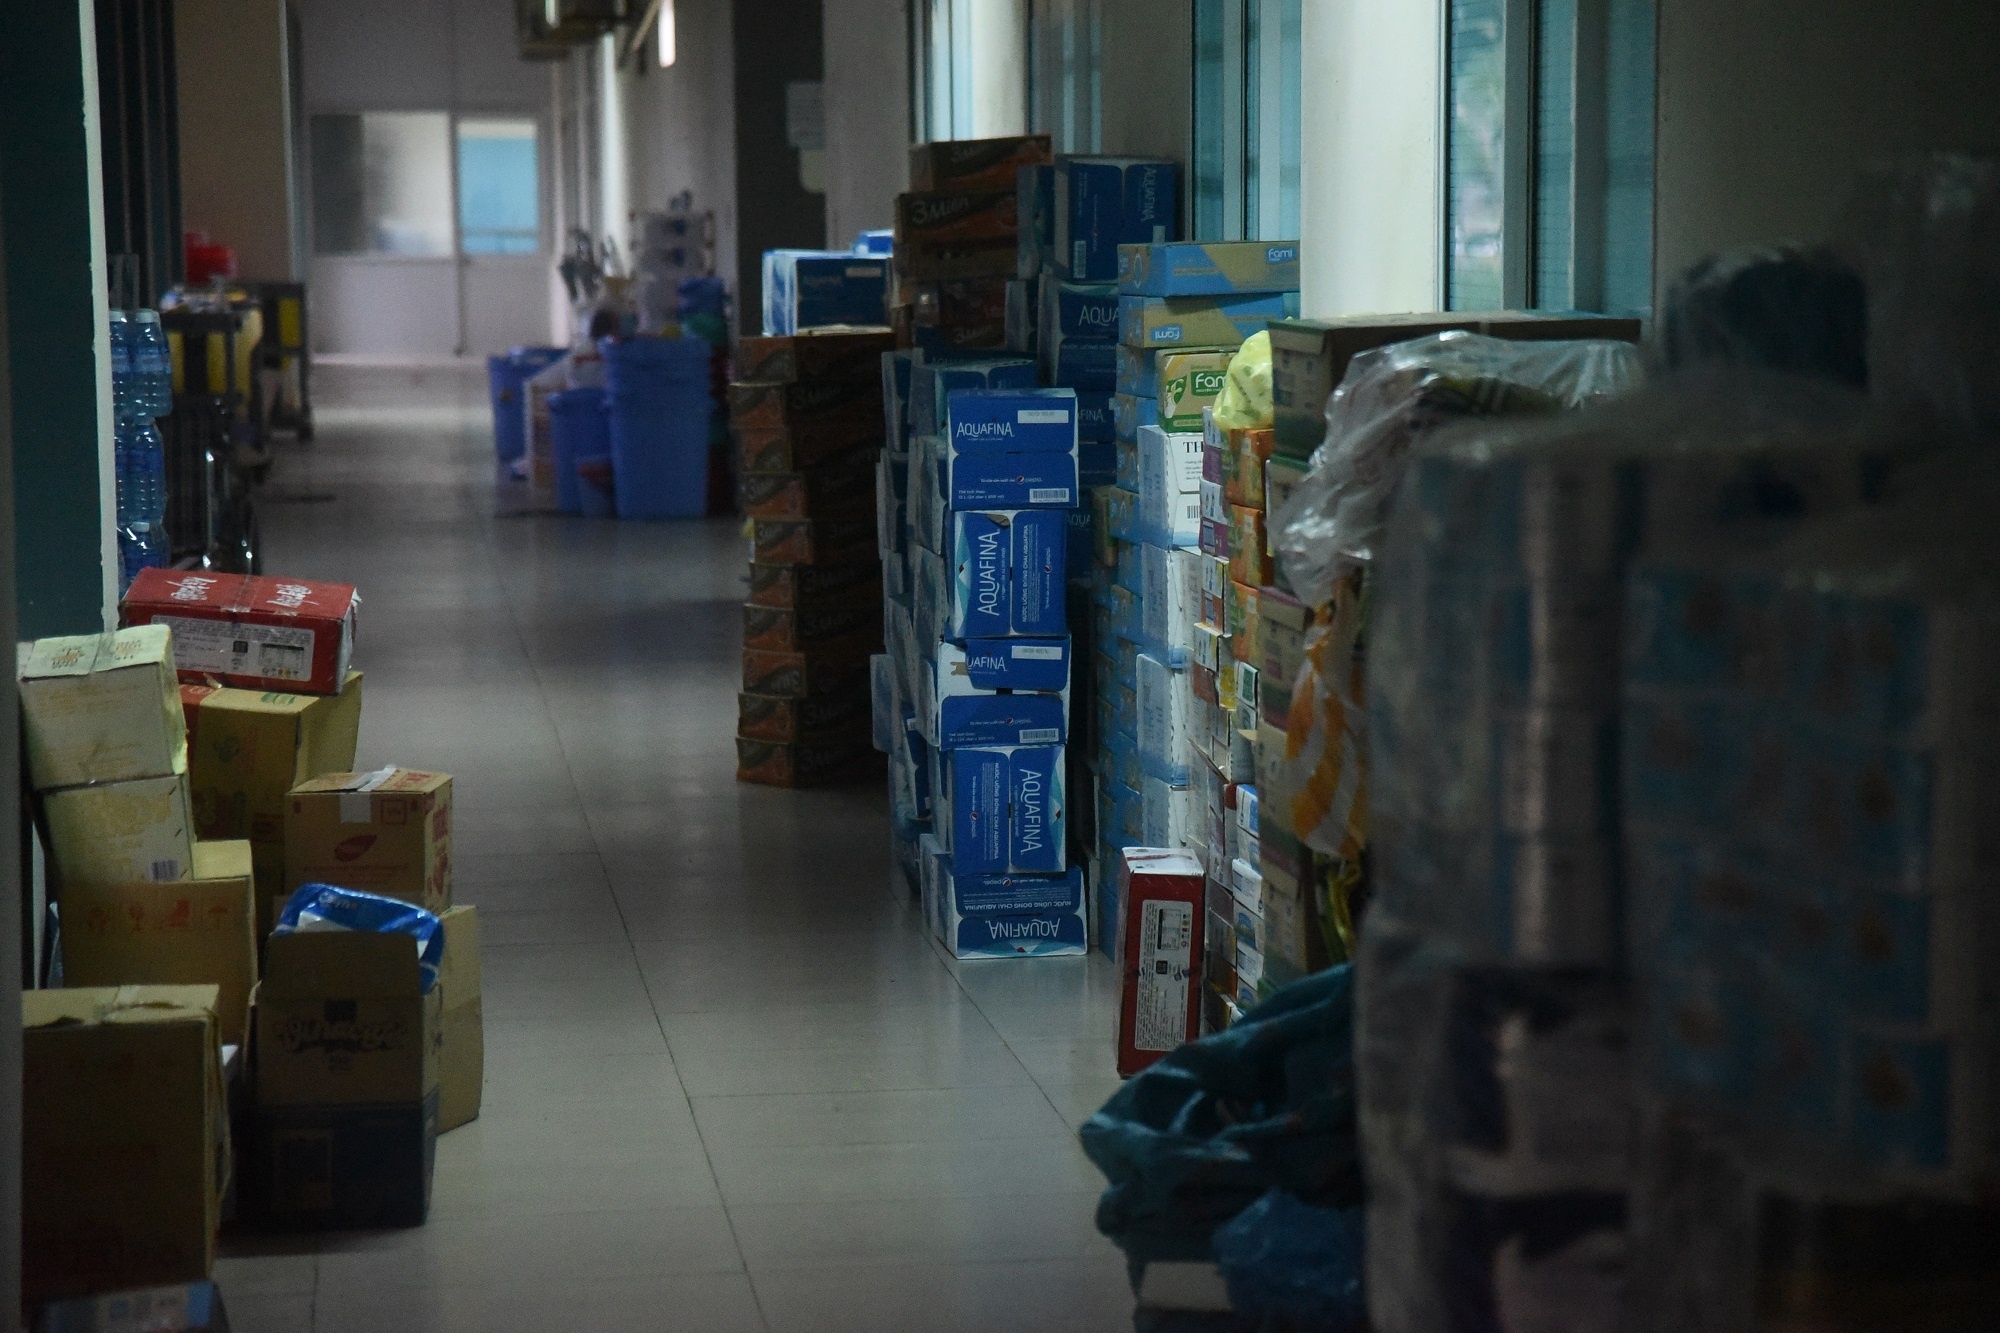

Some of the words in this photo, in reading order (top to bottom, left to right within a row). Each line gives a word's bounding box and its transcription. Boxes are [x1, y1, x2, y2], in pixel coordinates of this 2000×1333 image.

[1140, 166, 1157, 222] AQUAFINA
[1077, 408, 1104, 423] FINA
[956, 421, 1014, 438] AQUAFINA
[1183, 441, 1204, 453] TH
[977, 530, 1000, 616] AQUAFINA
[967, 656, 1007, 672] UAFINA
[1019, 768, 1043, 853] AQUAFINA
[987, 918, 1061, 940] AQUAFINA
